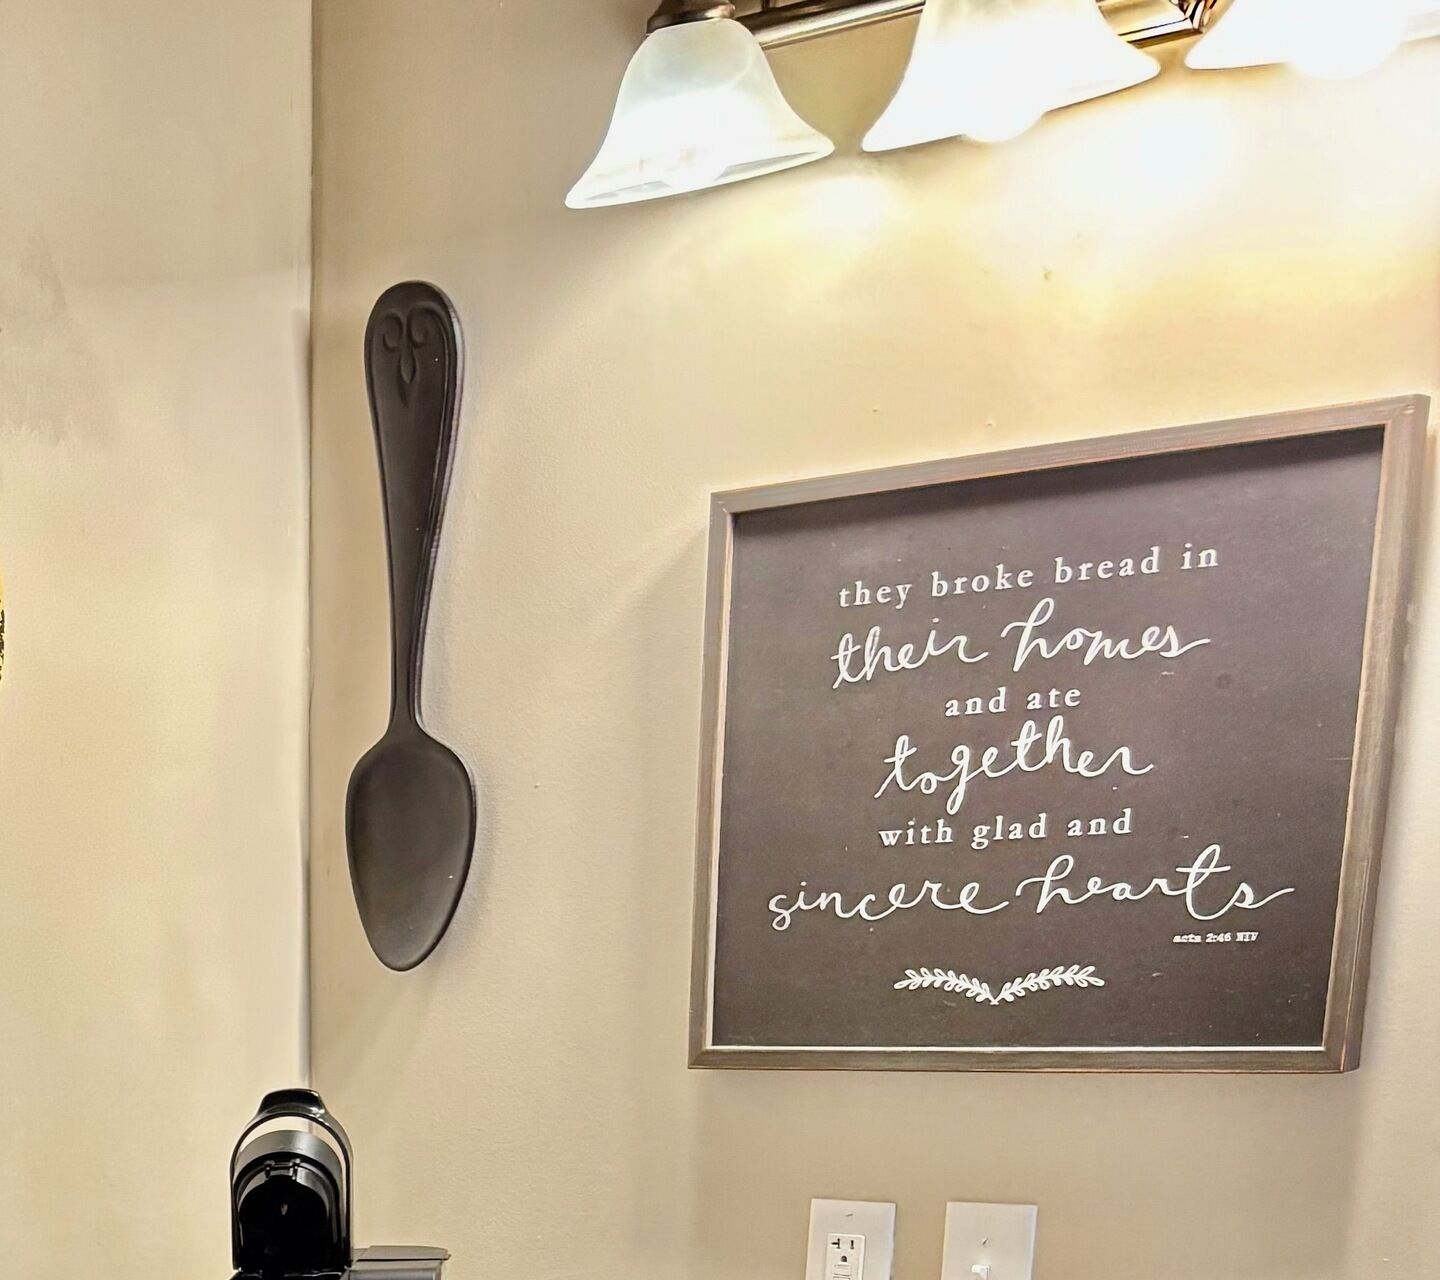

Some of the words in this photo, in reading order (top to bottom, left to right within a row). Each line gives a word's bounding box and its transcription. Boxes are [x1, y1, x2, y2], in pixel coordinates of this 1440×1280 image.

[839, 580, 913, 609] they
[930, 564, 1035, 598] broke
[1054, 546, 1160, 584] bread
[1180, 542, 1220, 570] in
[830, 617, 989, 690] their
[999, 597, 1212, 673] homes
[944, 686, 1007, 718] and
[1025, 686, 1082, 711] ate
[873, 715, 1155, 815] together
[877, 817, 954, 848] with
[971, 812, 1048, 851] glad
[1066, 807, 1133, 838] and
[767, 880, 1010, 931] sincere
[1015, 843, 1296, 921] hearts
[1205, 932, 1232, 943] 2:46
